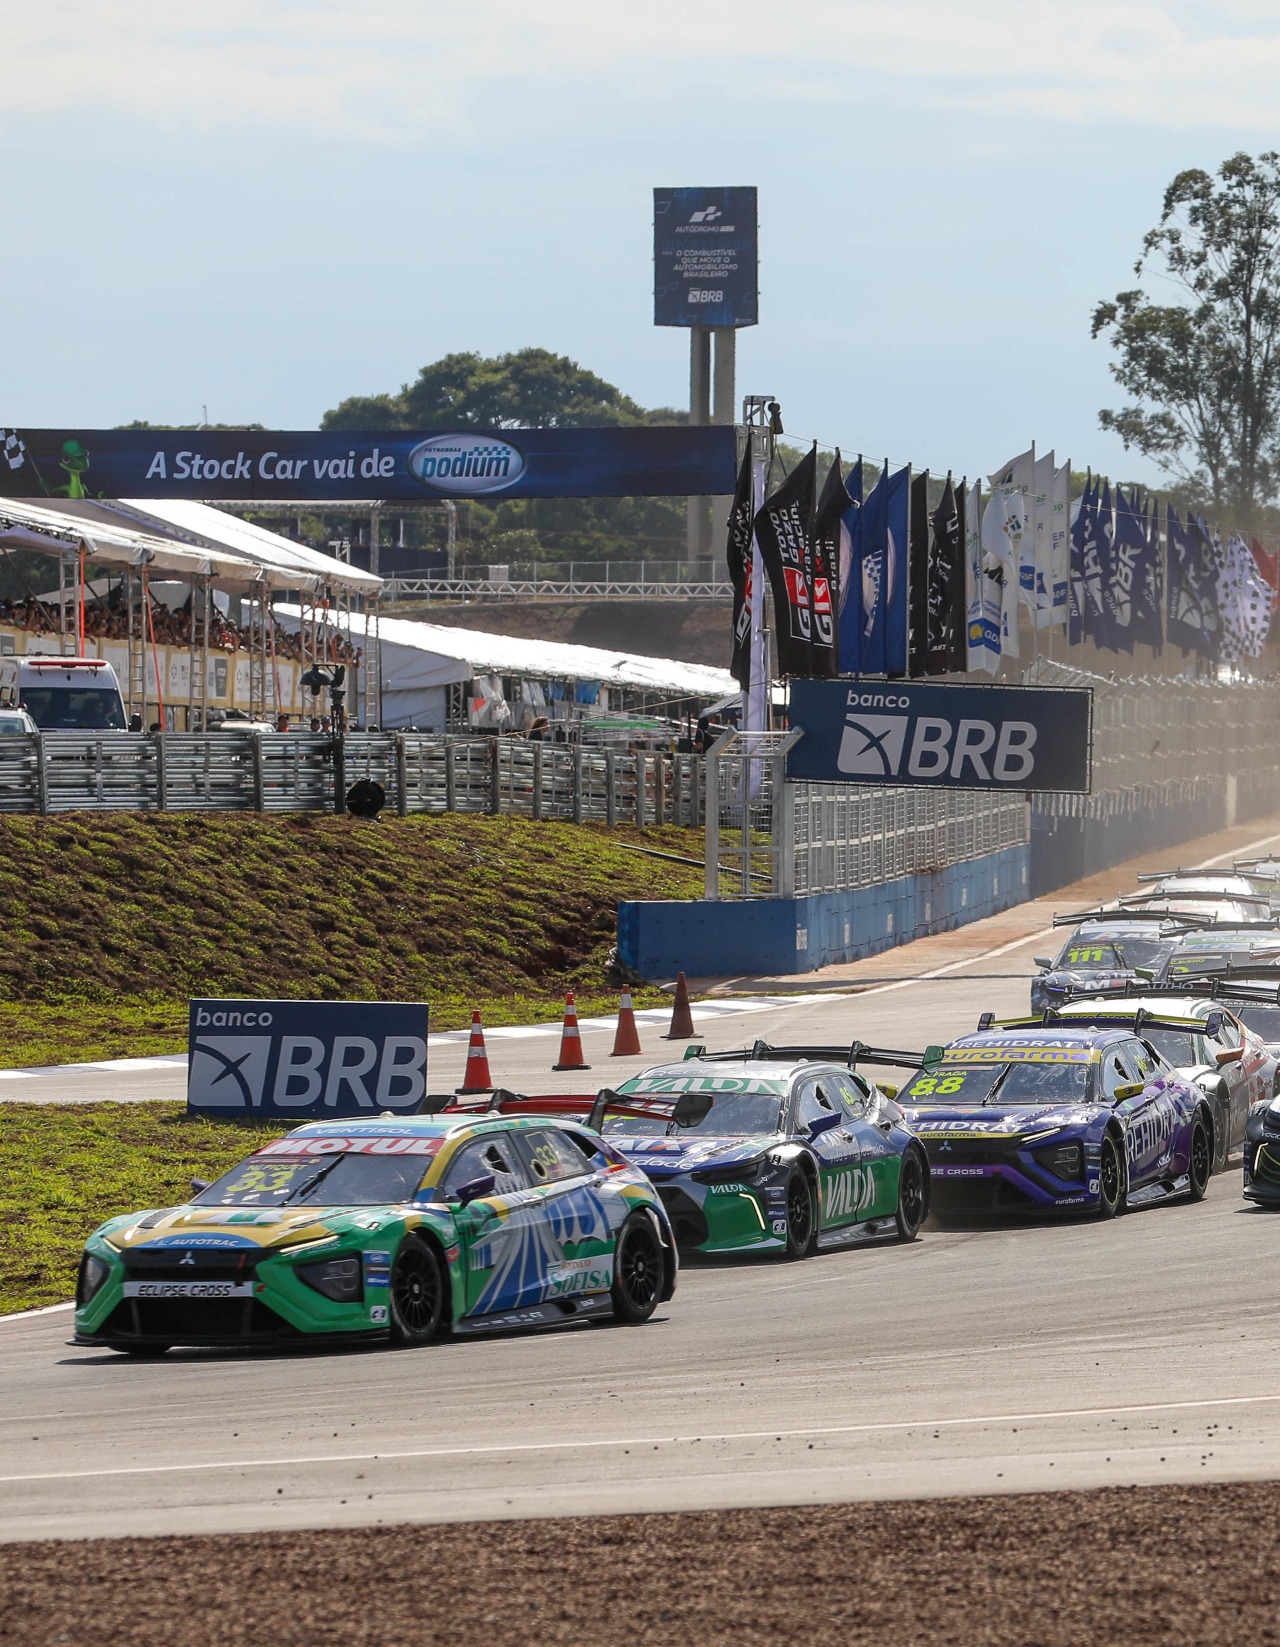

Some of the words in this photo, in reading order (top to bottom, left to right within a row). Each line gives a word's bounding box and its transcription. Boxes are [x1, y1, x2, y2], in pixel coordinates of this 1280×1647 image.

[683, 270, 728, 278] BRASILEIRO
[700, 290, 723, 302] BRB
[146, 451, 165, 479] A
[173, 452, 251, 480] Stock
[259, 451, 307, 480] Car
[314, 450, 355, 480] vai
[361, 448, 395, 478] de
[421, 449, 511, 480] podium
[846, 690, 911, 709] banco
[907, 717, 1038, 781] BRB
[1067, 951, 1104, 964] 111
[196, 1007, 273, 1027] banco
[957, 1040, 1080, 1049] REHIDRAT
[272, 1036, 427, 1107] BRB
[634, 1077, 779, 1094] VALDA
[909, 1077, 966, 1096] 88
[315, 1126, 415, 1137] VENTISOL
[255, 1138, 442, 1156] MOTUL
[226, 1170, 294, 1192] 33
[710, 1184, 748, 1194] VALDA
[826, 1165, 875, 1220] VALDA
[1055, 1196, 1085, 1205] eurofarma
[171, 1238, 239, 1247] AUTOTRAC
[138, 1284, 186, 1297] ECLIPSE
[189, 1283, 231, 1297] CROSS
[549, 1269, 611, 1297] SOFISA
